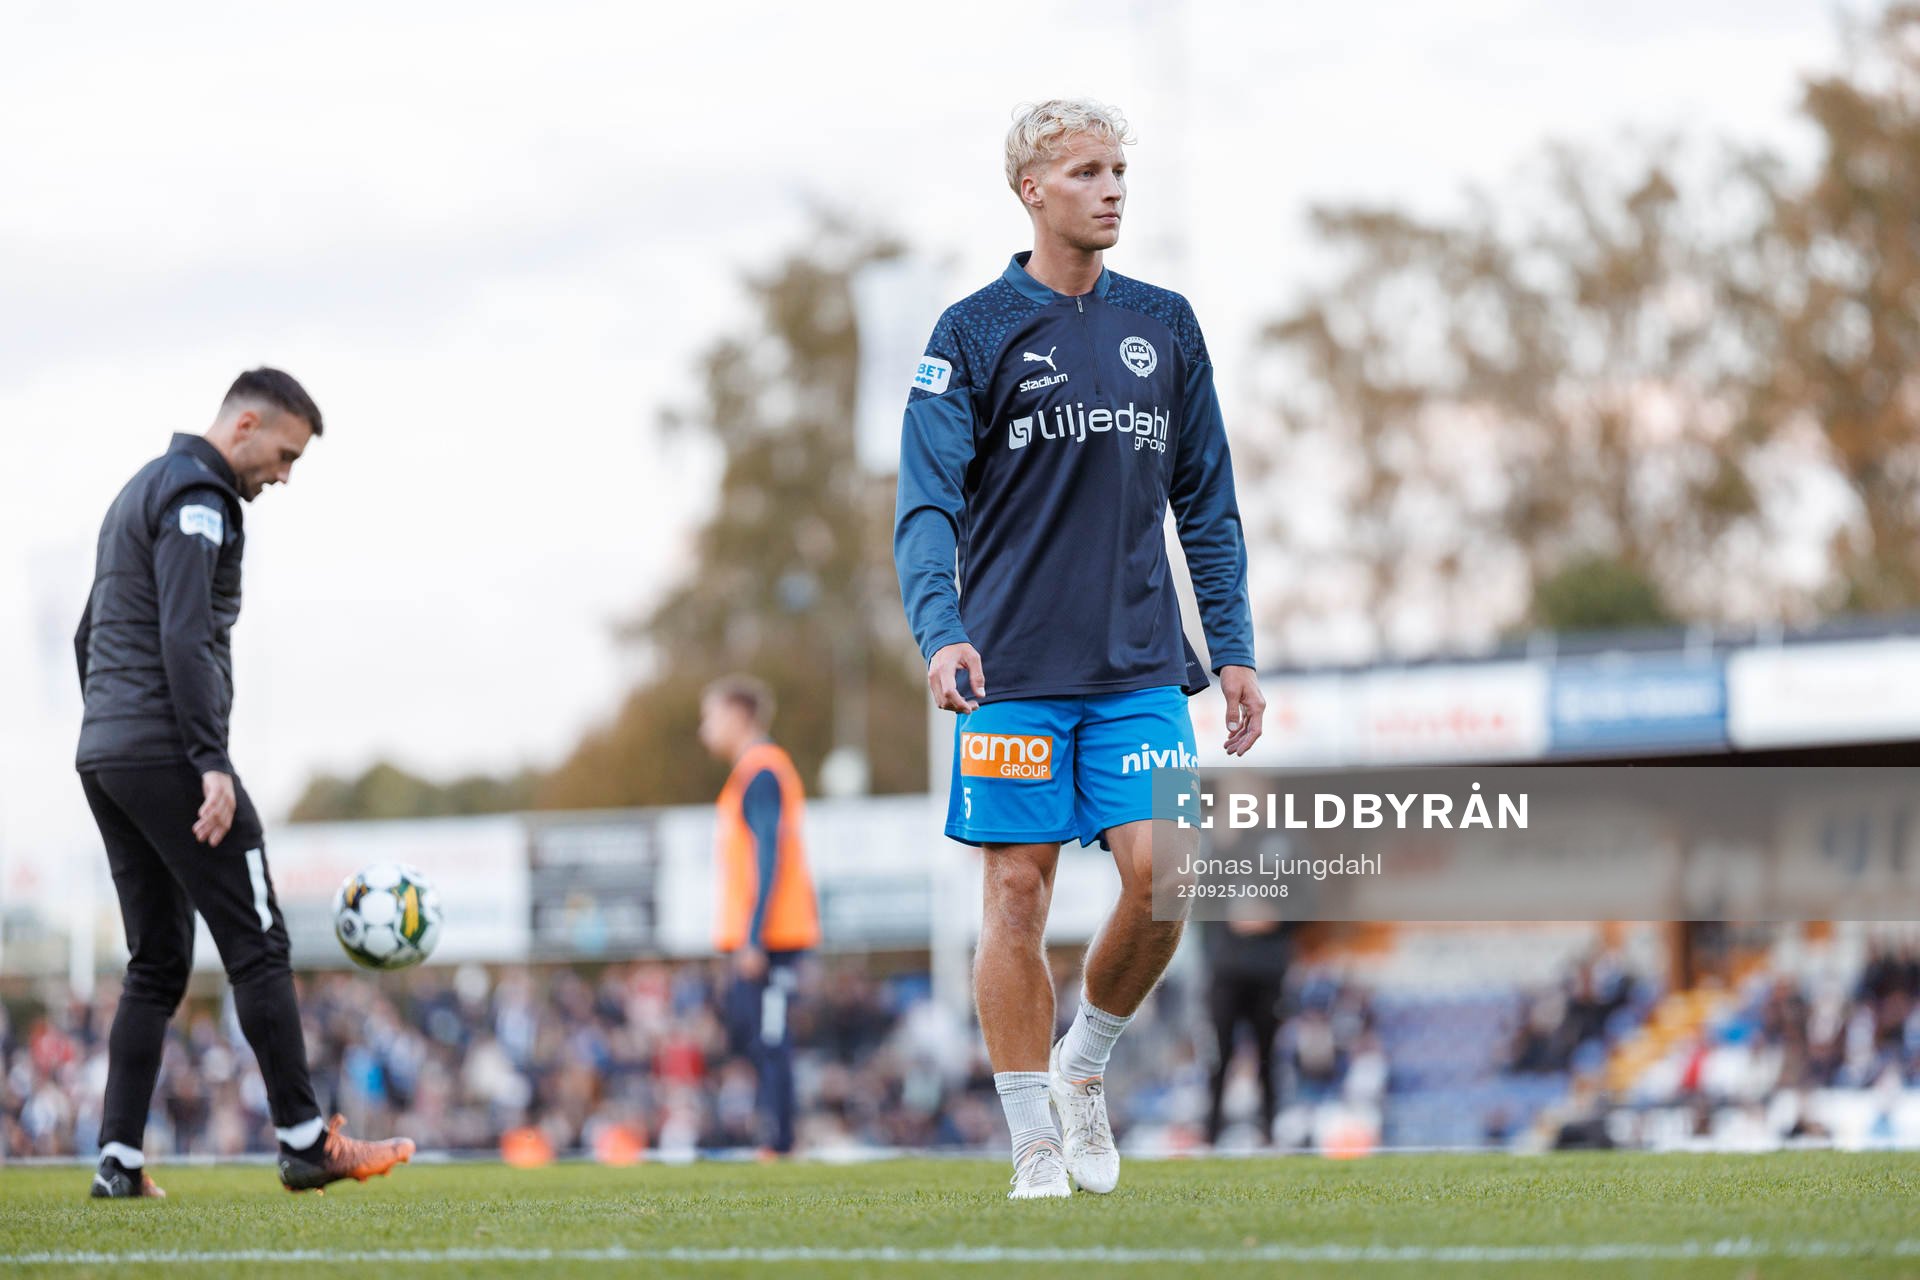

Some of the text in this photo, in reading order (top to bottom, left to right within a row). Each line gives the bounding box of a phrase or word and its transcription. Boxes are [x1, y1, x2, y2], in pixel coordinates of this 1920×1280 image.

[1128, 344, 1146, 353] IFK
[1019, 373, 1069, 392] stadium
[1037, 402, 1170, 443] Liljedahl
[962, 734, 1049, 763] ramo
[1000, 764, 1048, 777] GROUP
[963, 787, 972, 820] 5
